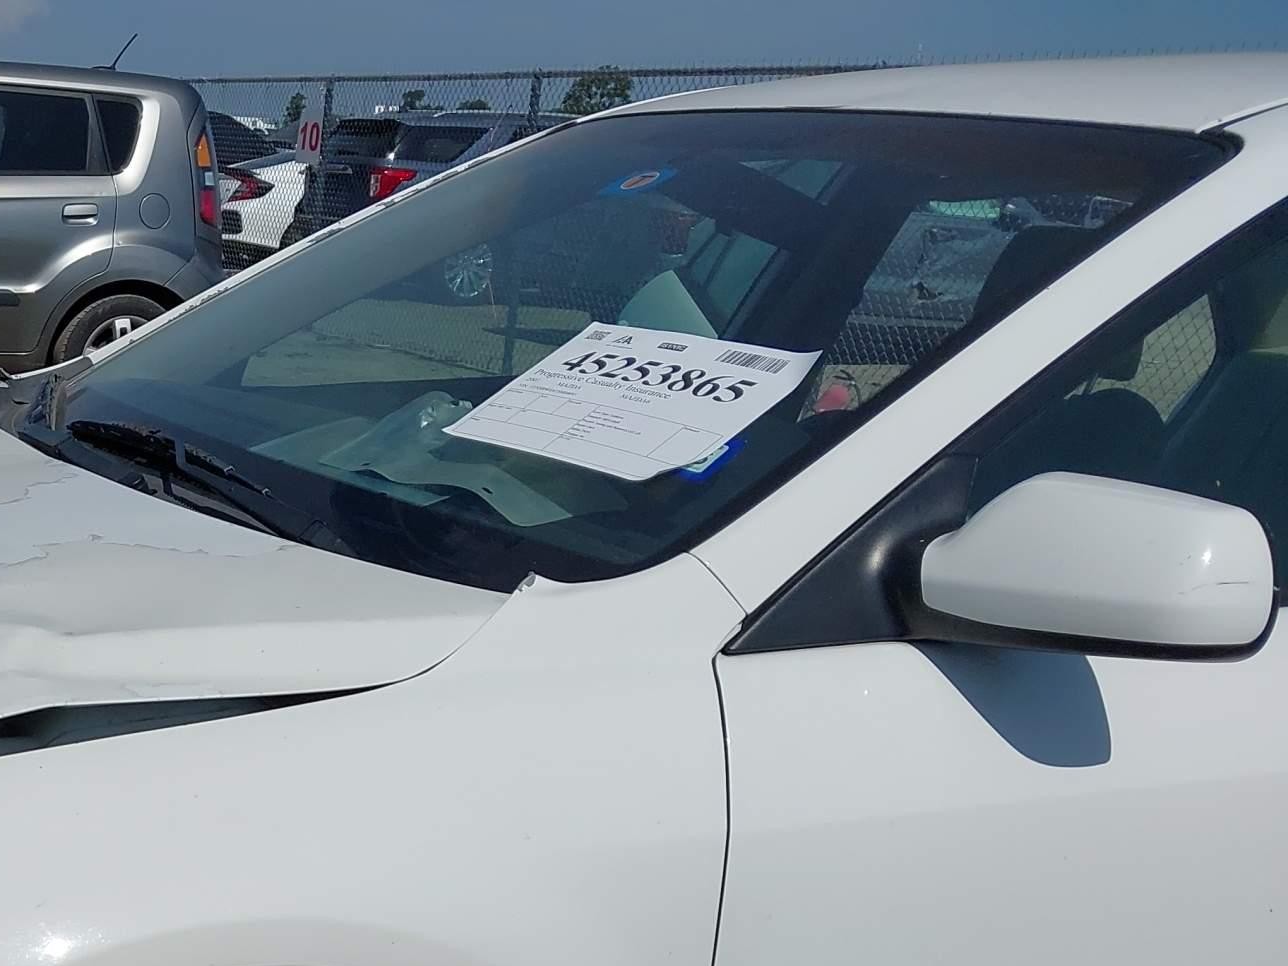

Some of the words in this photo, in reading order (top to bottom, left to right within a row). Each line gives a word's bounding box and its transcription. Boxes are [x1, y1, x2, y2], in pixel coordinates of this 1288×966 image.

[300, 121, 320, 151] 10
[534, 369, 584, 382] Progressive
[585, 377, 623, 390] Casualty
[626, 384, 672, 399] Insurance
[562, 352, 758, 402] 45253865
